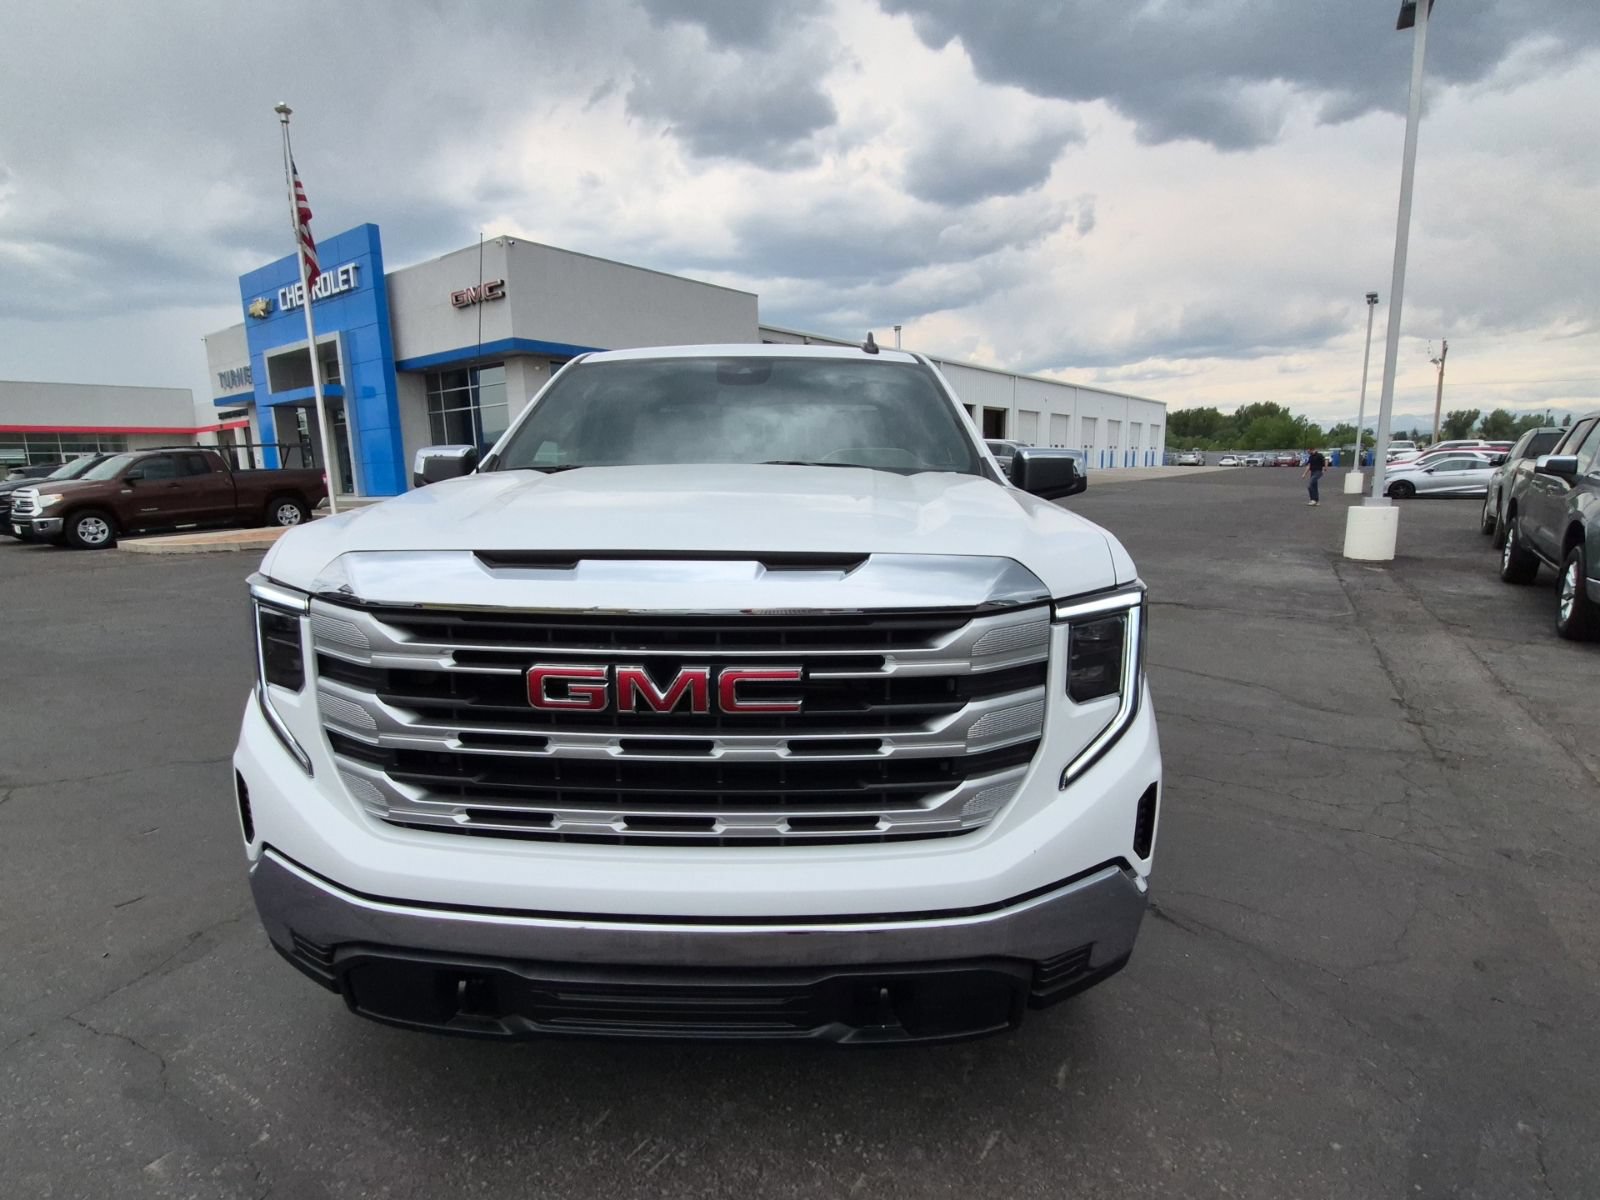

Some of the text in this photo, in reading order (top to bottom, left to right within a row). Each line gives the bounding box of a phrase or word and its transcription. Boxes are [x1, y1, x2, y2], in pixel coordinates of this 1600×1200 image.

[278, 262, 359, 311] CHEROLET
[451, 279, 505, 308] GMC
[526, 663, 803, 714] GMC
